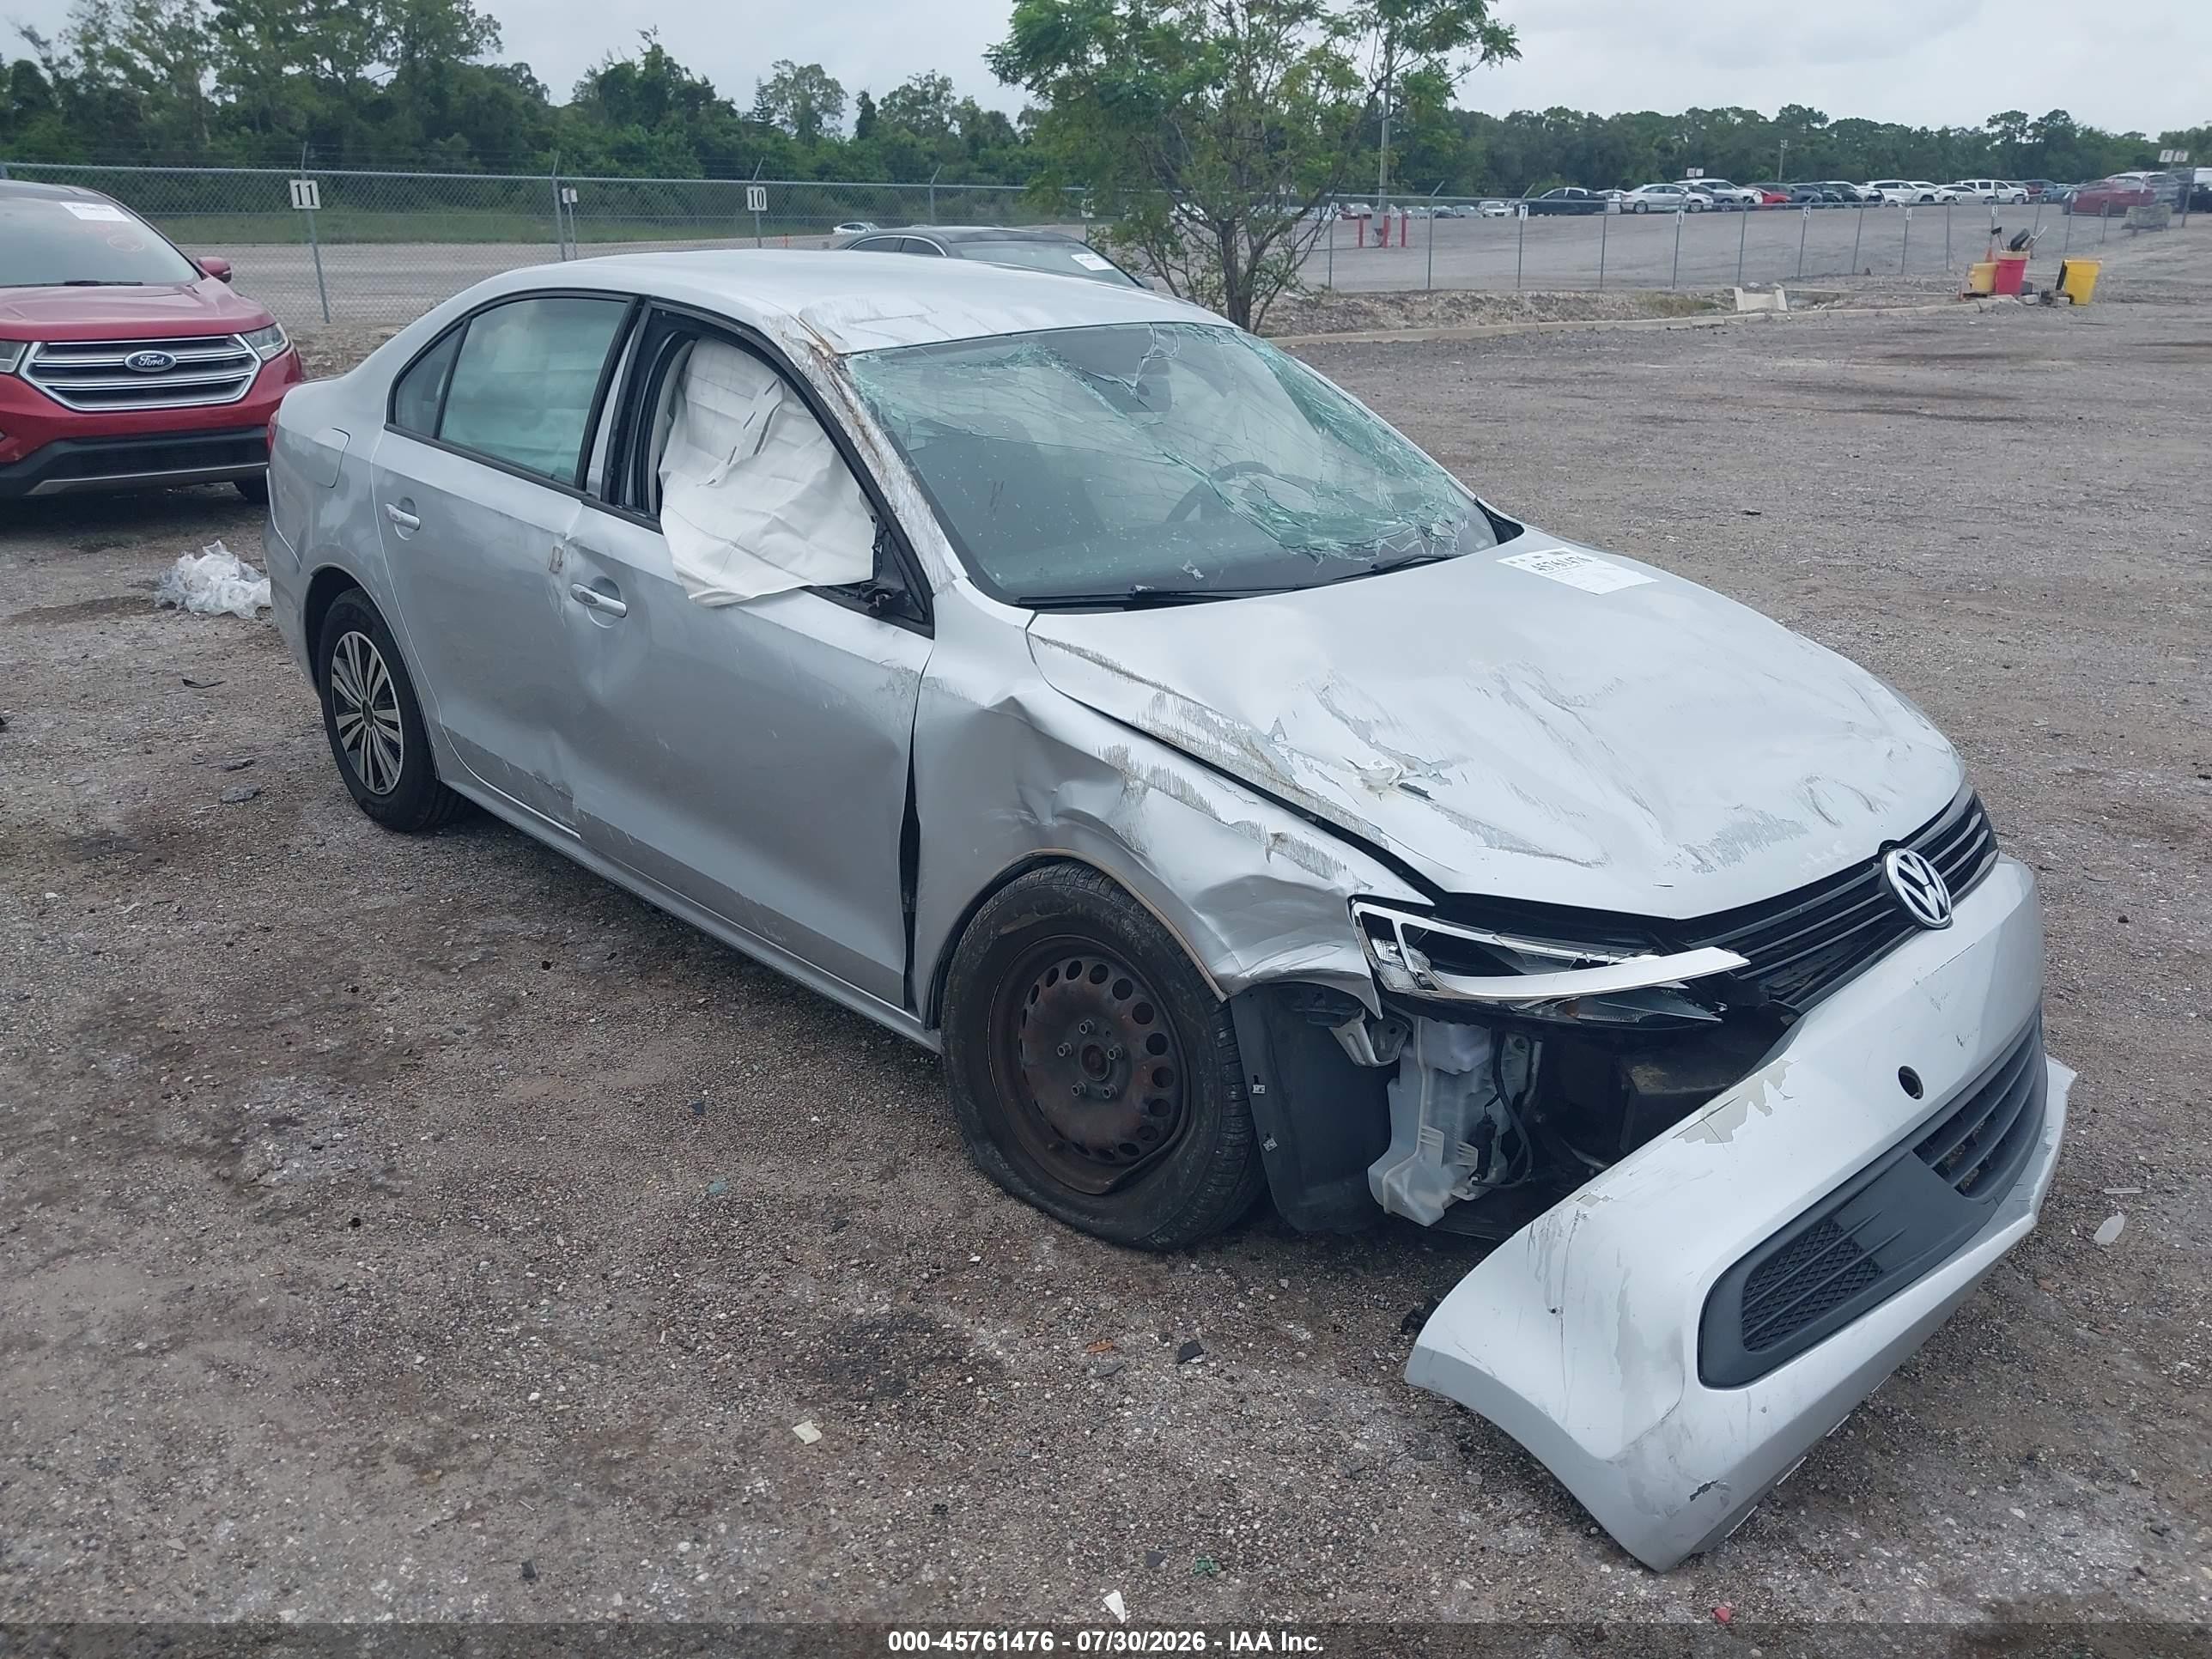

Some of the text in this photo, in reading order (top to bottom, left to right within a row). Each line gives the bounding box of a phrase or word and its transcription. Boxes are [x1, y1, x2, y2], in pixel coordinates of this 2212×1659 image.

[295, 183, 316, 207] 11
[750, 189, 765, 209] 10
[1521, 205, 1527, 220] 7
[137, 355, 166, 367] Ford
